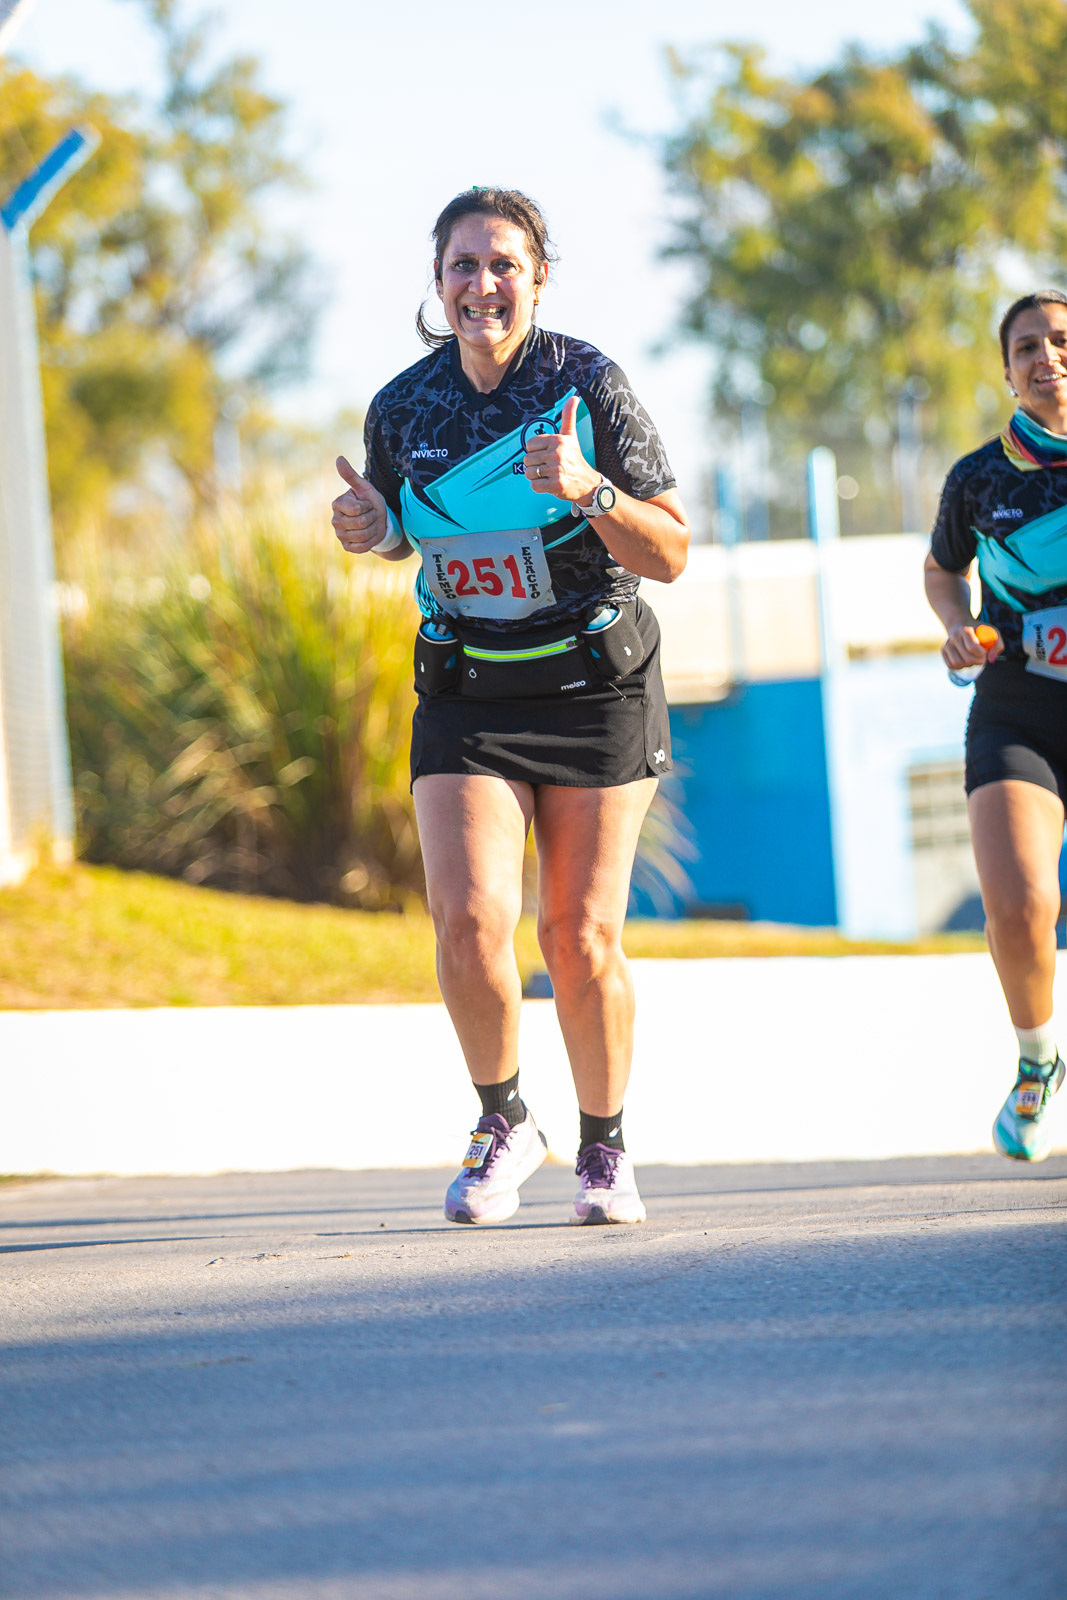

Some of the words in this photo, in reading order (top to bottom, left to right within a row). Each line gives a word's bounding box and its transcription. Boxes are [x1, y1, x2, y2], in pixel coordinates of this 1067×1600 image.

[411, 448, 449, 459] INVICTO
[432, 553, 457, 600] TIEMPO
[446, 554, 527, 599] 251
[521, 546, 541, 600] EXACTO
